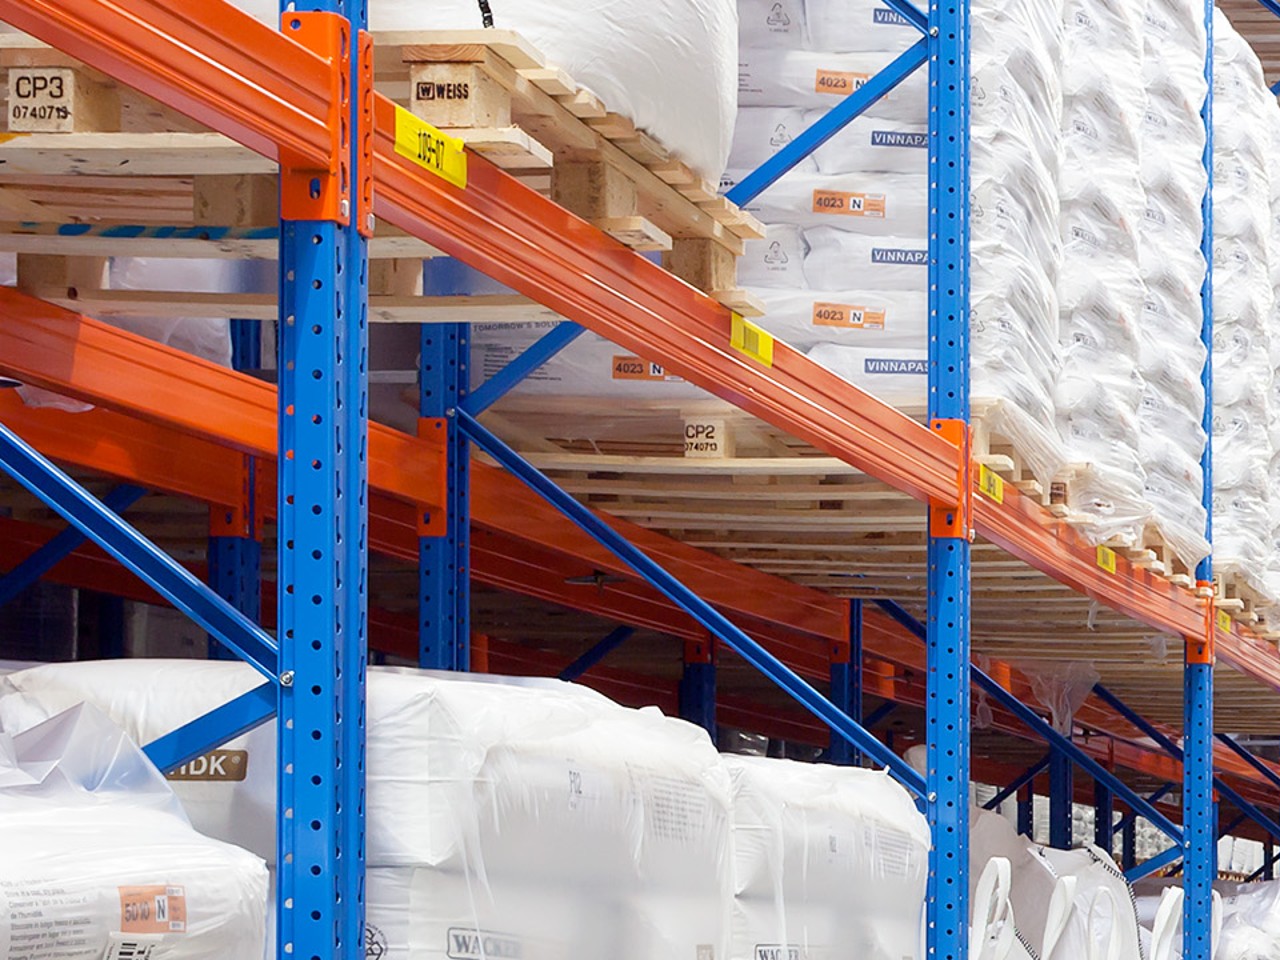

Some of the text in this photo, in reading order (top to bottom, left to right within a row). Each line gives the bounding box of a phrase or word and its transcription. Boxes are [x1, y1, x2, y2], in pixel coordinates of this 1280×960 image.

[15, 75, 64, 100] CP3
[818, 77, 847, 89] 4023
[436, 81, 470, 100] WEISS
[816, 197, 844, 209] 4023
[816, 310, 844, 321] 4023
[616, 363, 644, 374] 4023
[685, 425, 715, 439] CP2
[156, 897, 167, 921] N
